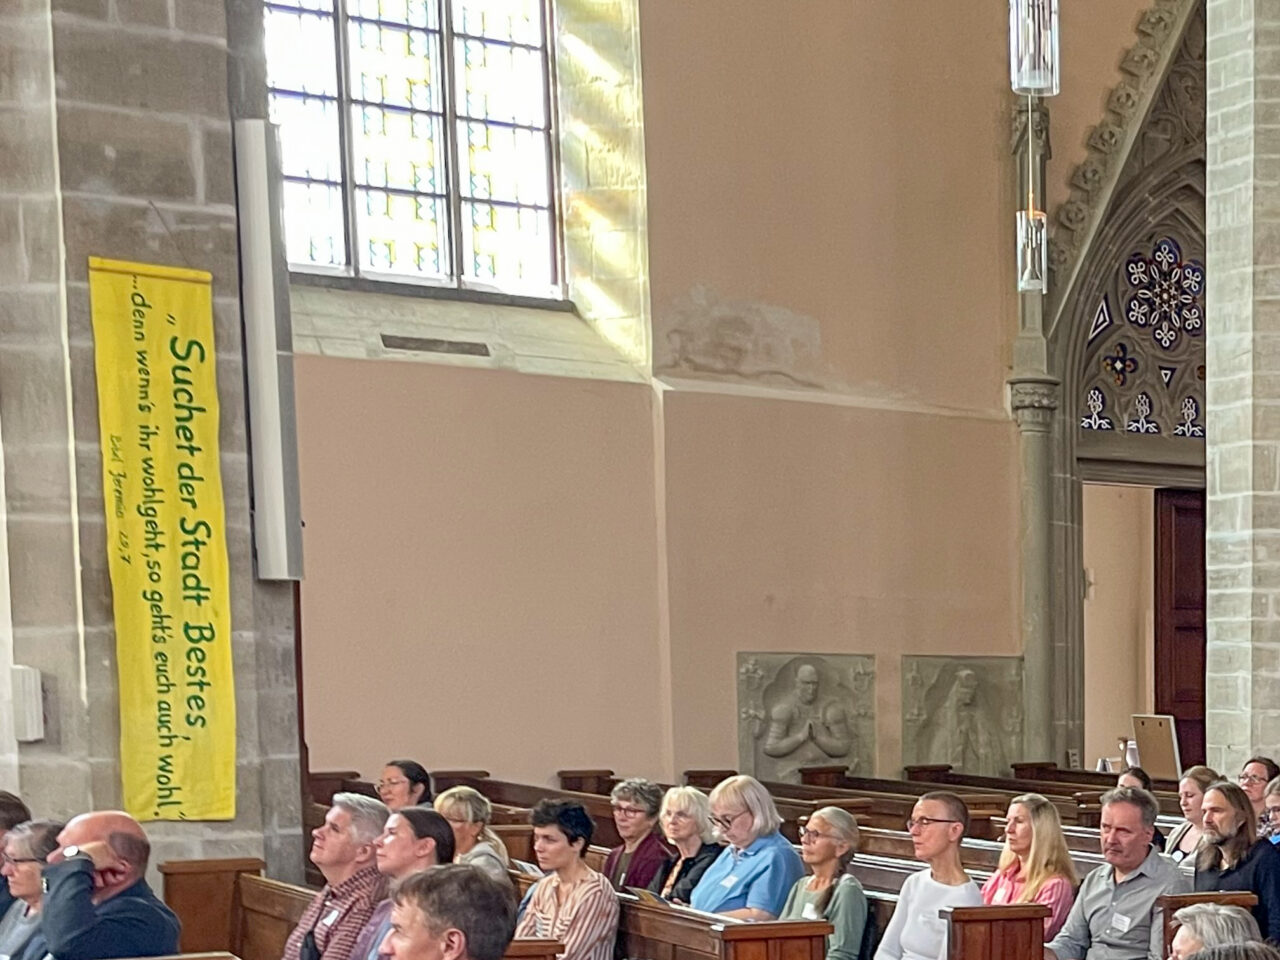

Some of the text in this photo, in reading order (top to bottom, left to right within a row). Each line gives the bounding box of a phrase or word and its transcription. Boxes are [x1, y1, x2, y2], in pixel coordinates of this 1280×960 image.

[137, 424, 160, 451] ihr
[177, 462, 205, 509] der
[179, 517, 212, 607] Stadt
[154, 651, 177, 694] euch
[157, 700, 179, 748] auch
